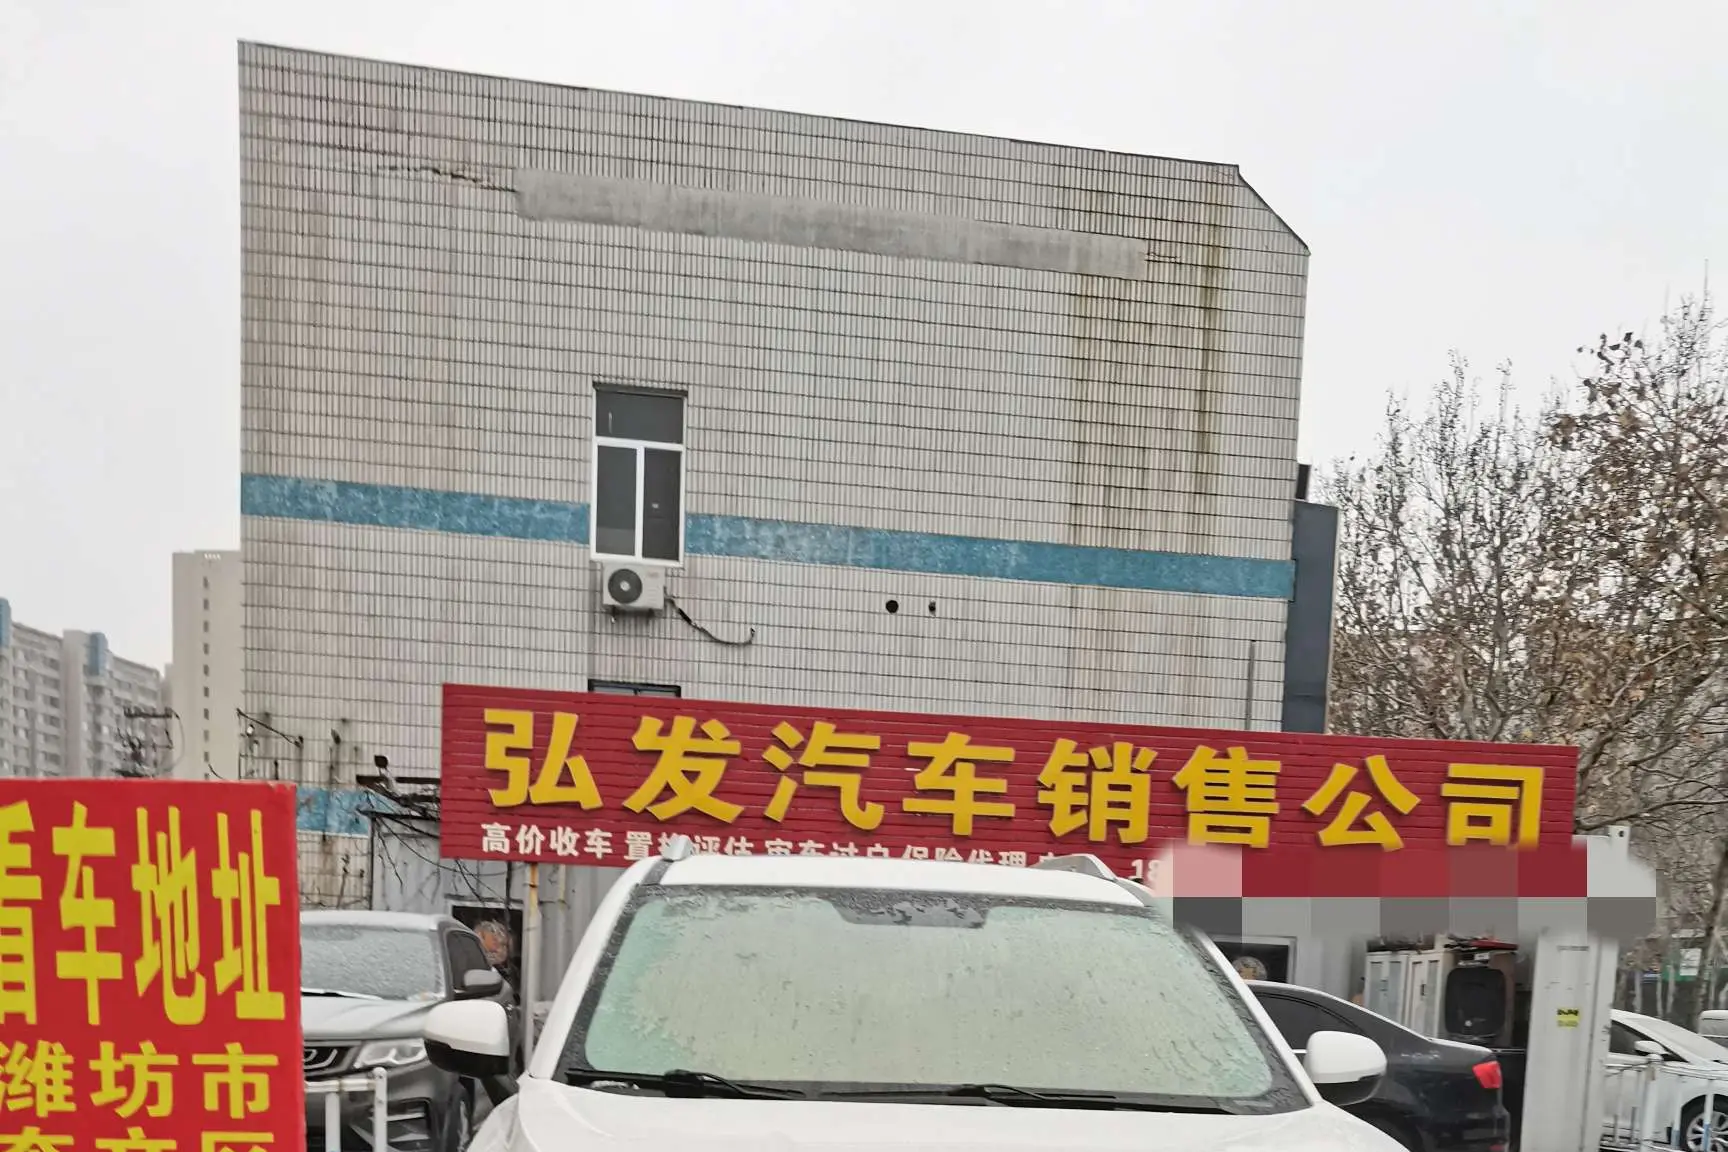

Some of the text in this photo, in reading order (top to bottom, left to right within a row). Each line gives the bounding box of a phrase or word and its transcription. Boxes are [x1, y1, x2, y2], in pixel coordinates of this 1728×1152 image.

[484, 708, 1544, 851] 弘发汽车销售公司
[481, 822, 613, 859] 高价收车
[0, 1040, 279, 1119] 潍坊市
